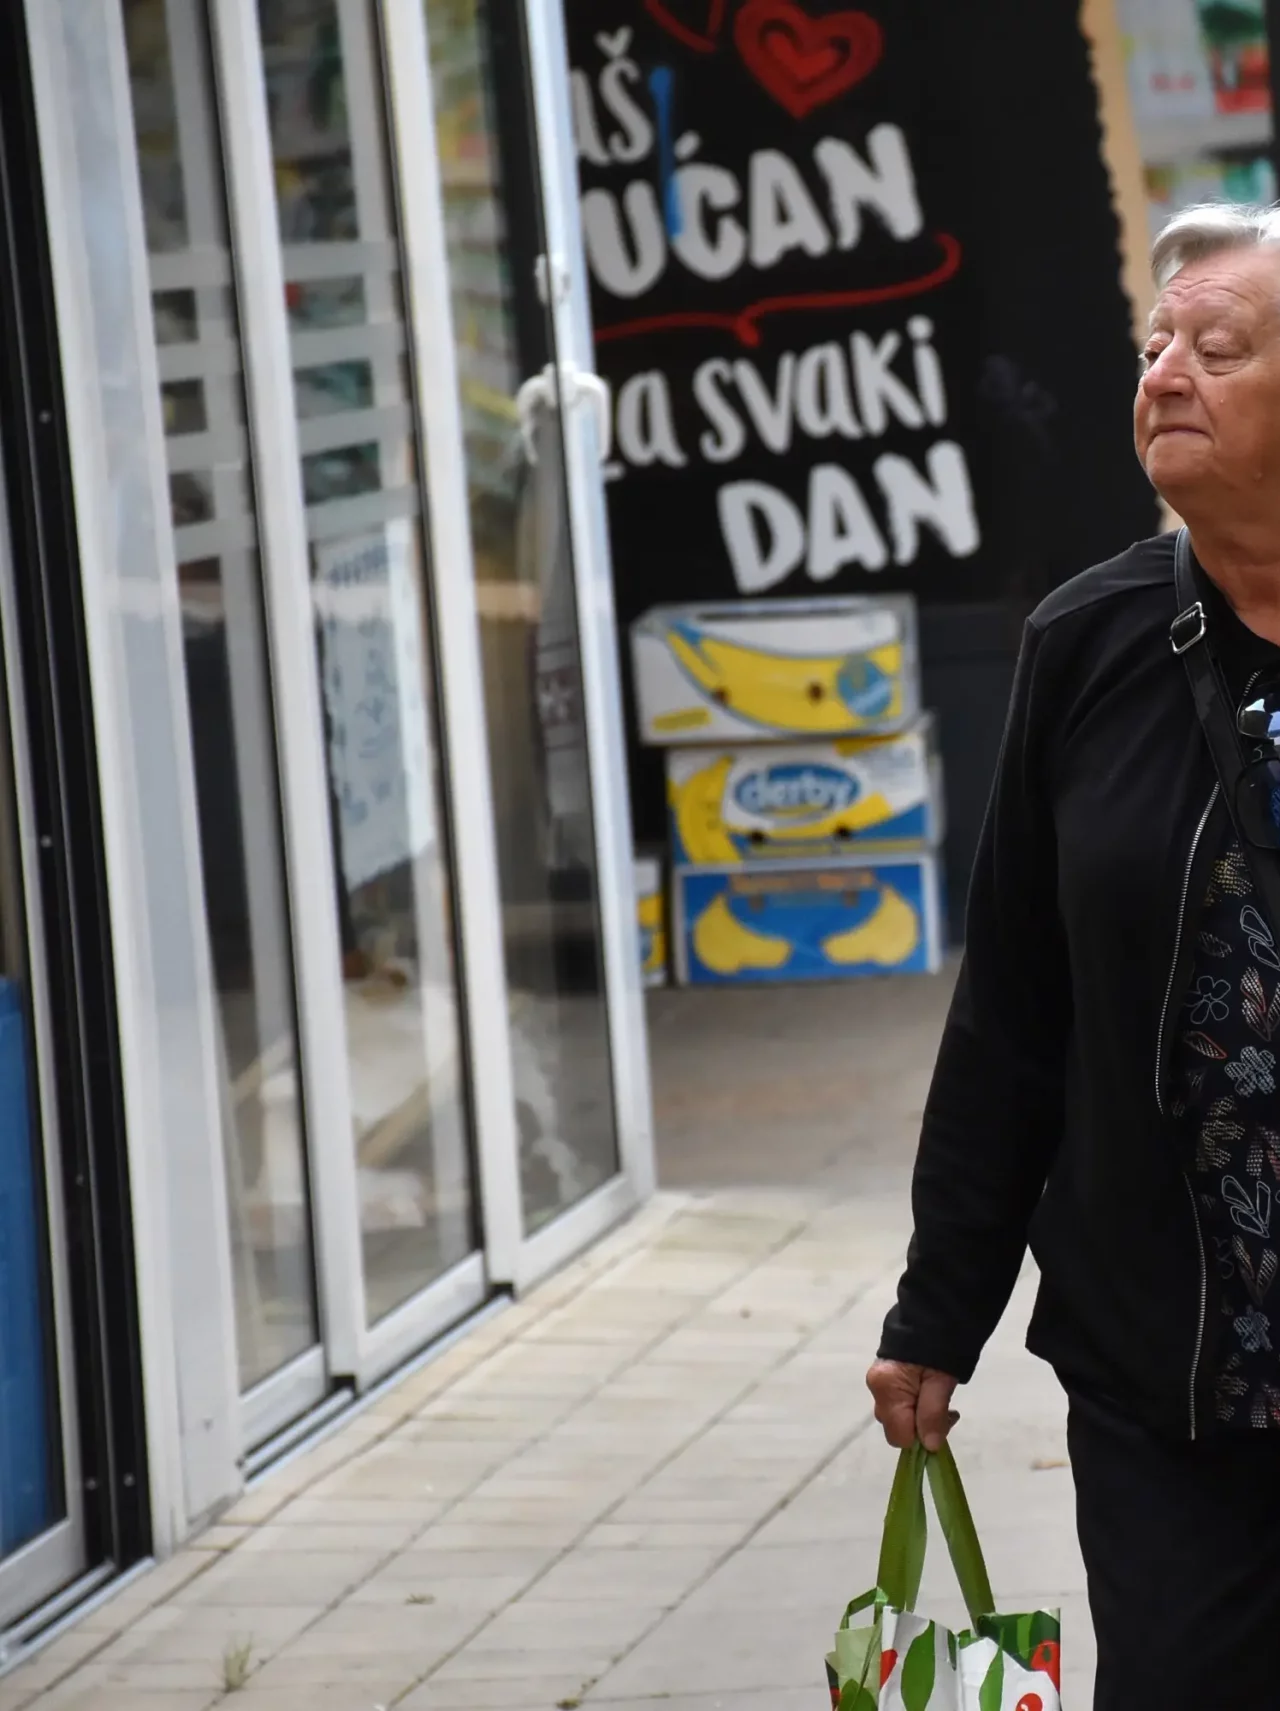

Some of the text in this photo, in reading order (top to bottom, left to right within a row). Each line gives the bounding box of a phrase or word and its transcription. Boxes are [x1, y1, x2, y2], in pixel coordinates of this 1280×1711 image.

[582, 123, 923, 297] UĆAN
[603, 370, 688, 481] a
[717, 441, 980, 593] DAN
